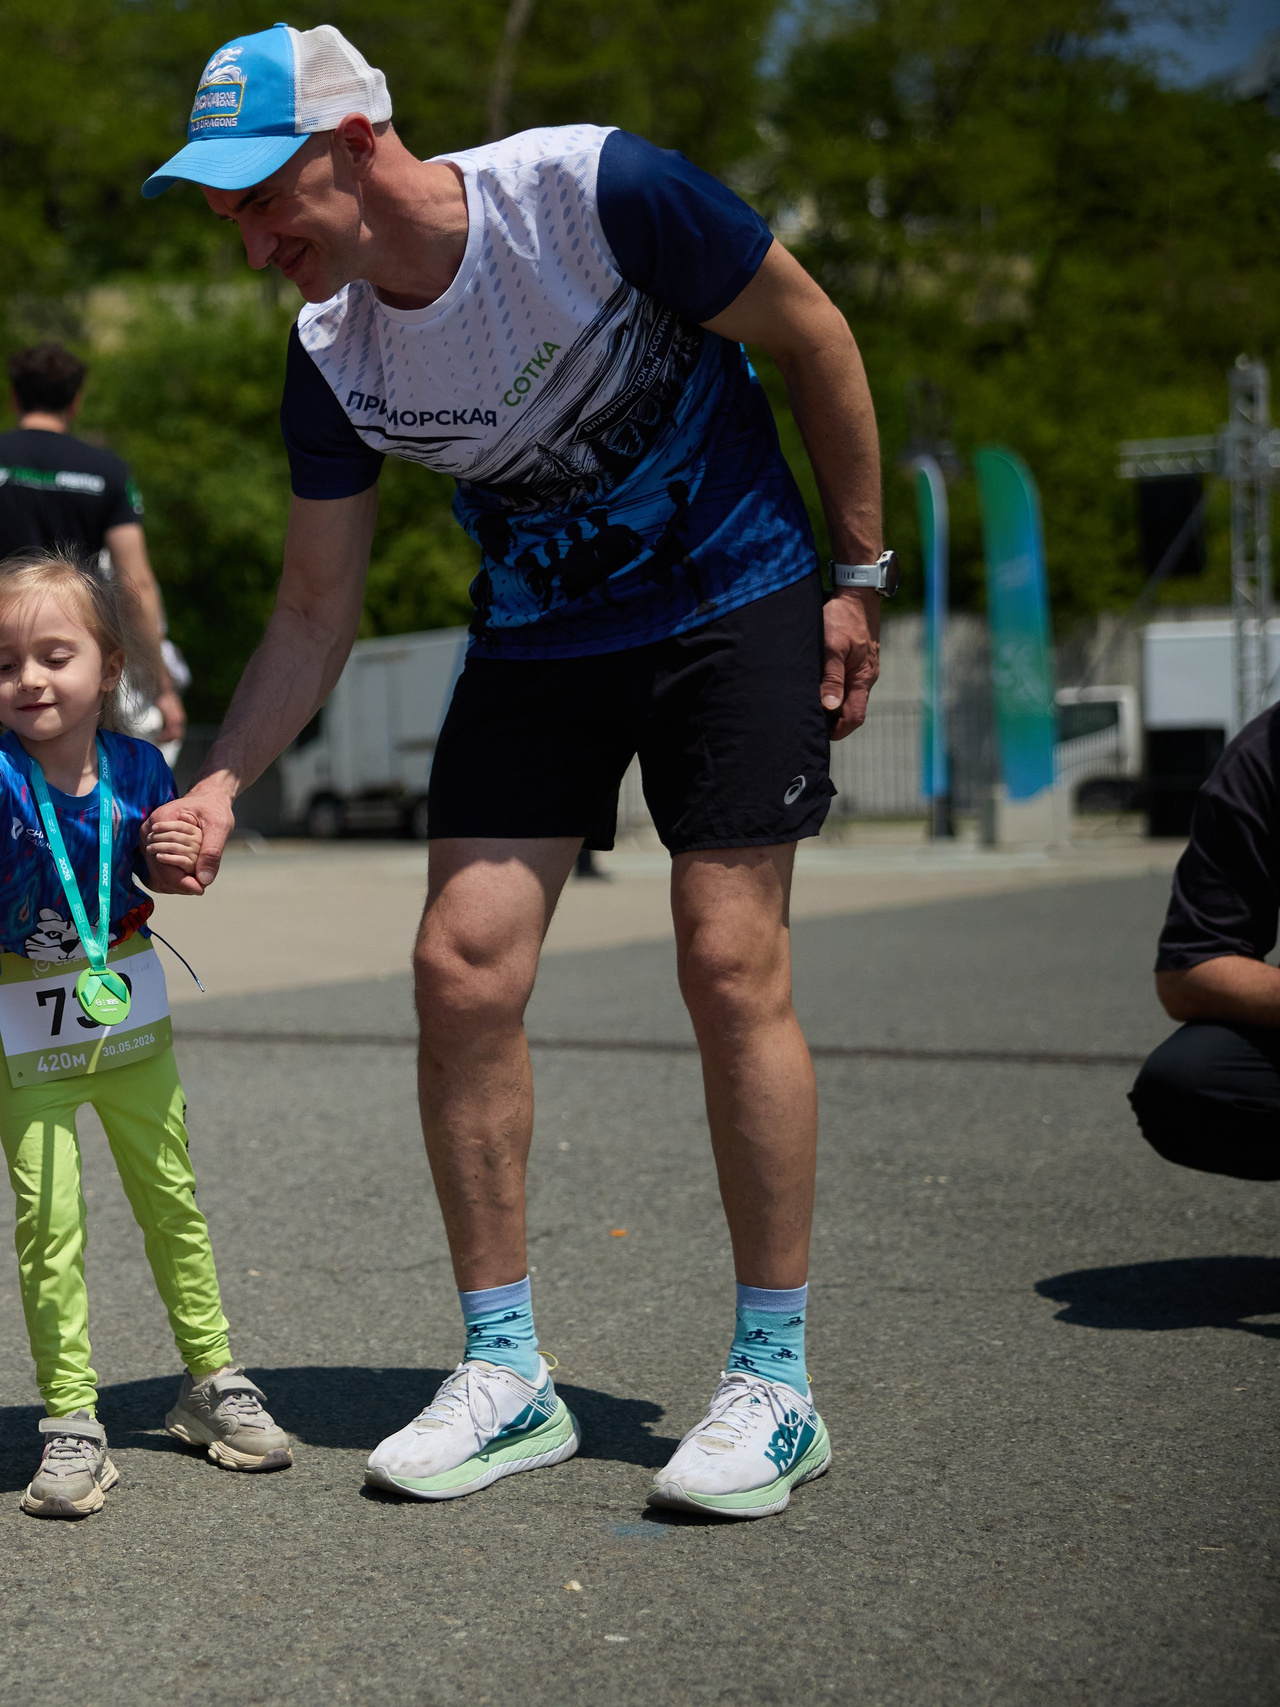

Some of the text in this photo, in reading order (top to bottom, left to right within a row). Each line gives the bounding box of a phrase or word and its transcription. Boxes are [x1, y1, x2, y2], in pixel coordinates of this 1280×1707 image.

[219, 91, 236, 100] ONE
[219, 99, 237, 107] ONE
[503, 341, 561, 407] СОТКА
[642, 358, 662, 390] 100КМ
[583, 367, 650, 433] ВЛАДИВОСТОК
[101, 756, 109, 780] 2026
[58, 857, 72, 882] 2026
[102, 1033, 155, 1057] 30.05.2026
